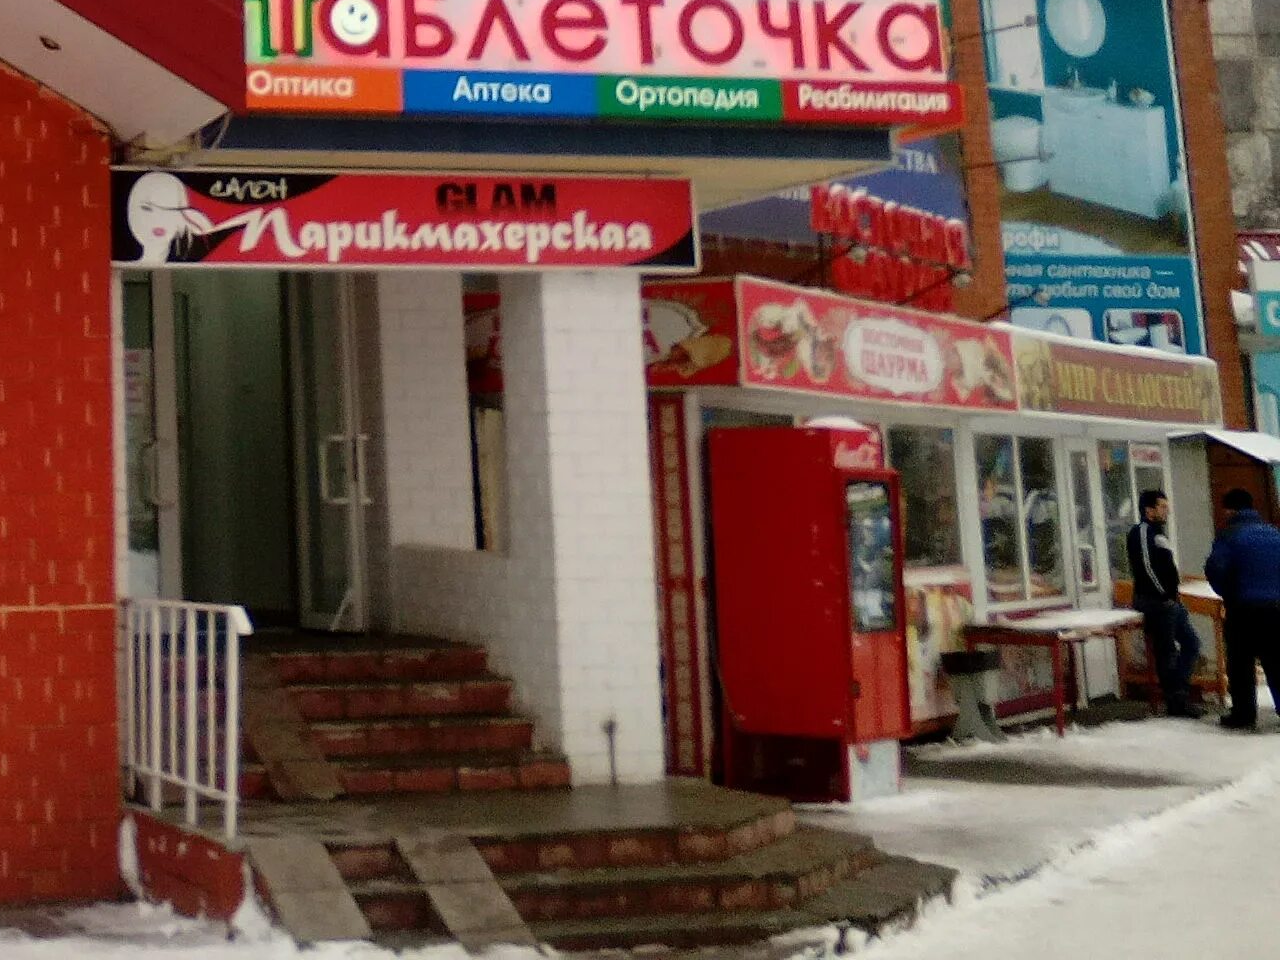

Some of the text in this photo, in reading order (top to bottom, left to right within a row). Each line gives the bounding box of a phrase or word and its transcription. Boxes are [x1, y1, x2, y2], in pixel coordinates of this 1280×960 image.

[247, 70, 951, 114] Оптика Аптека Ортопедия Реабилитация
[214, 207, 653, 263] Парикмахерская
